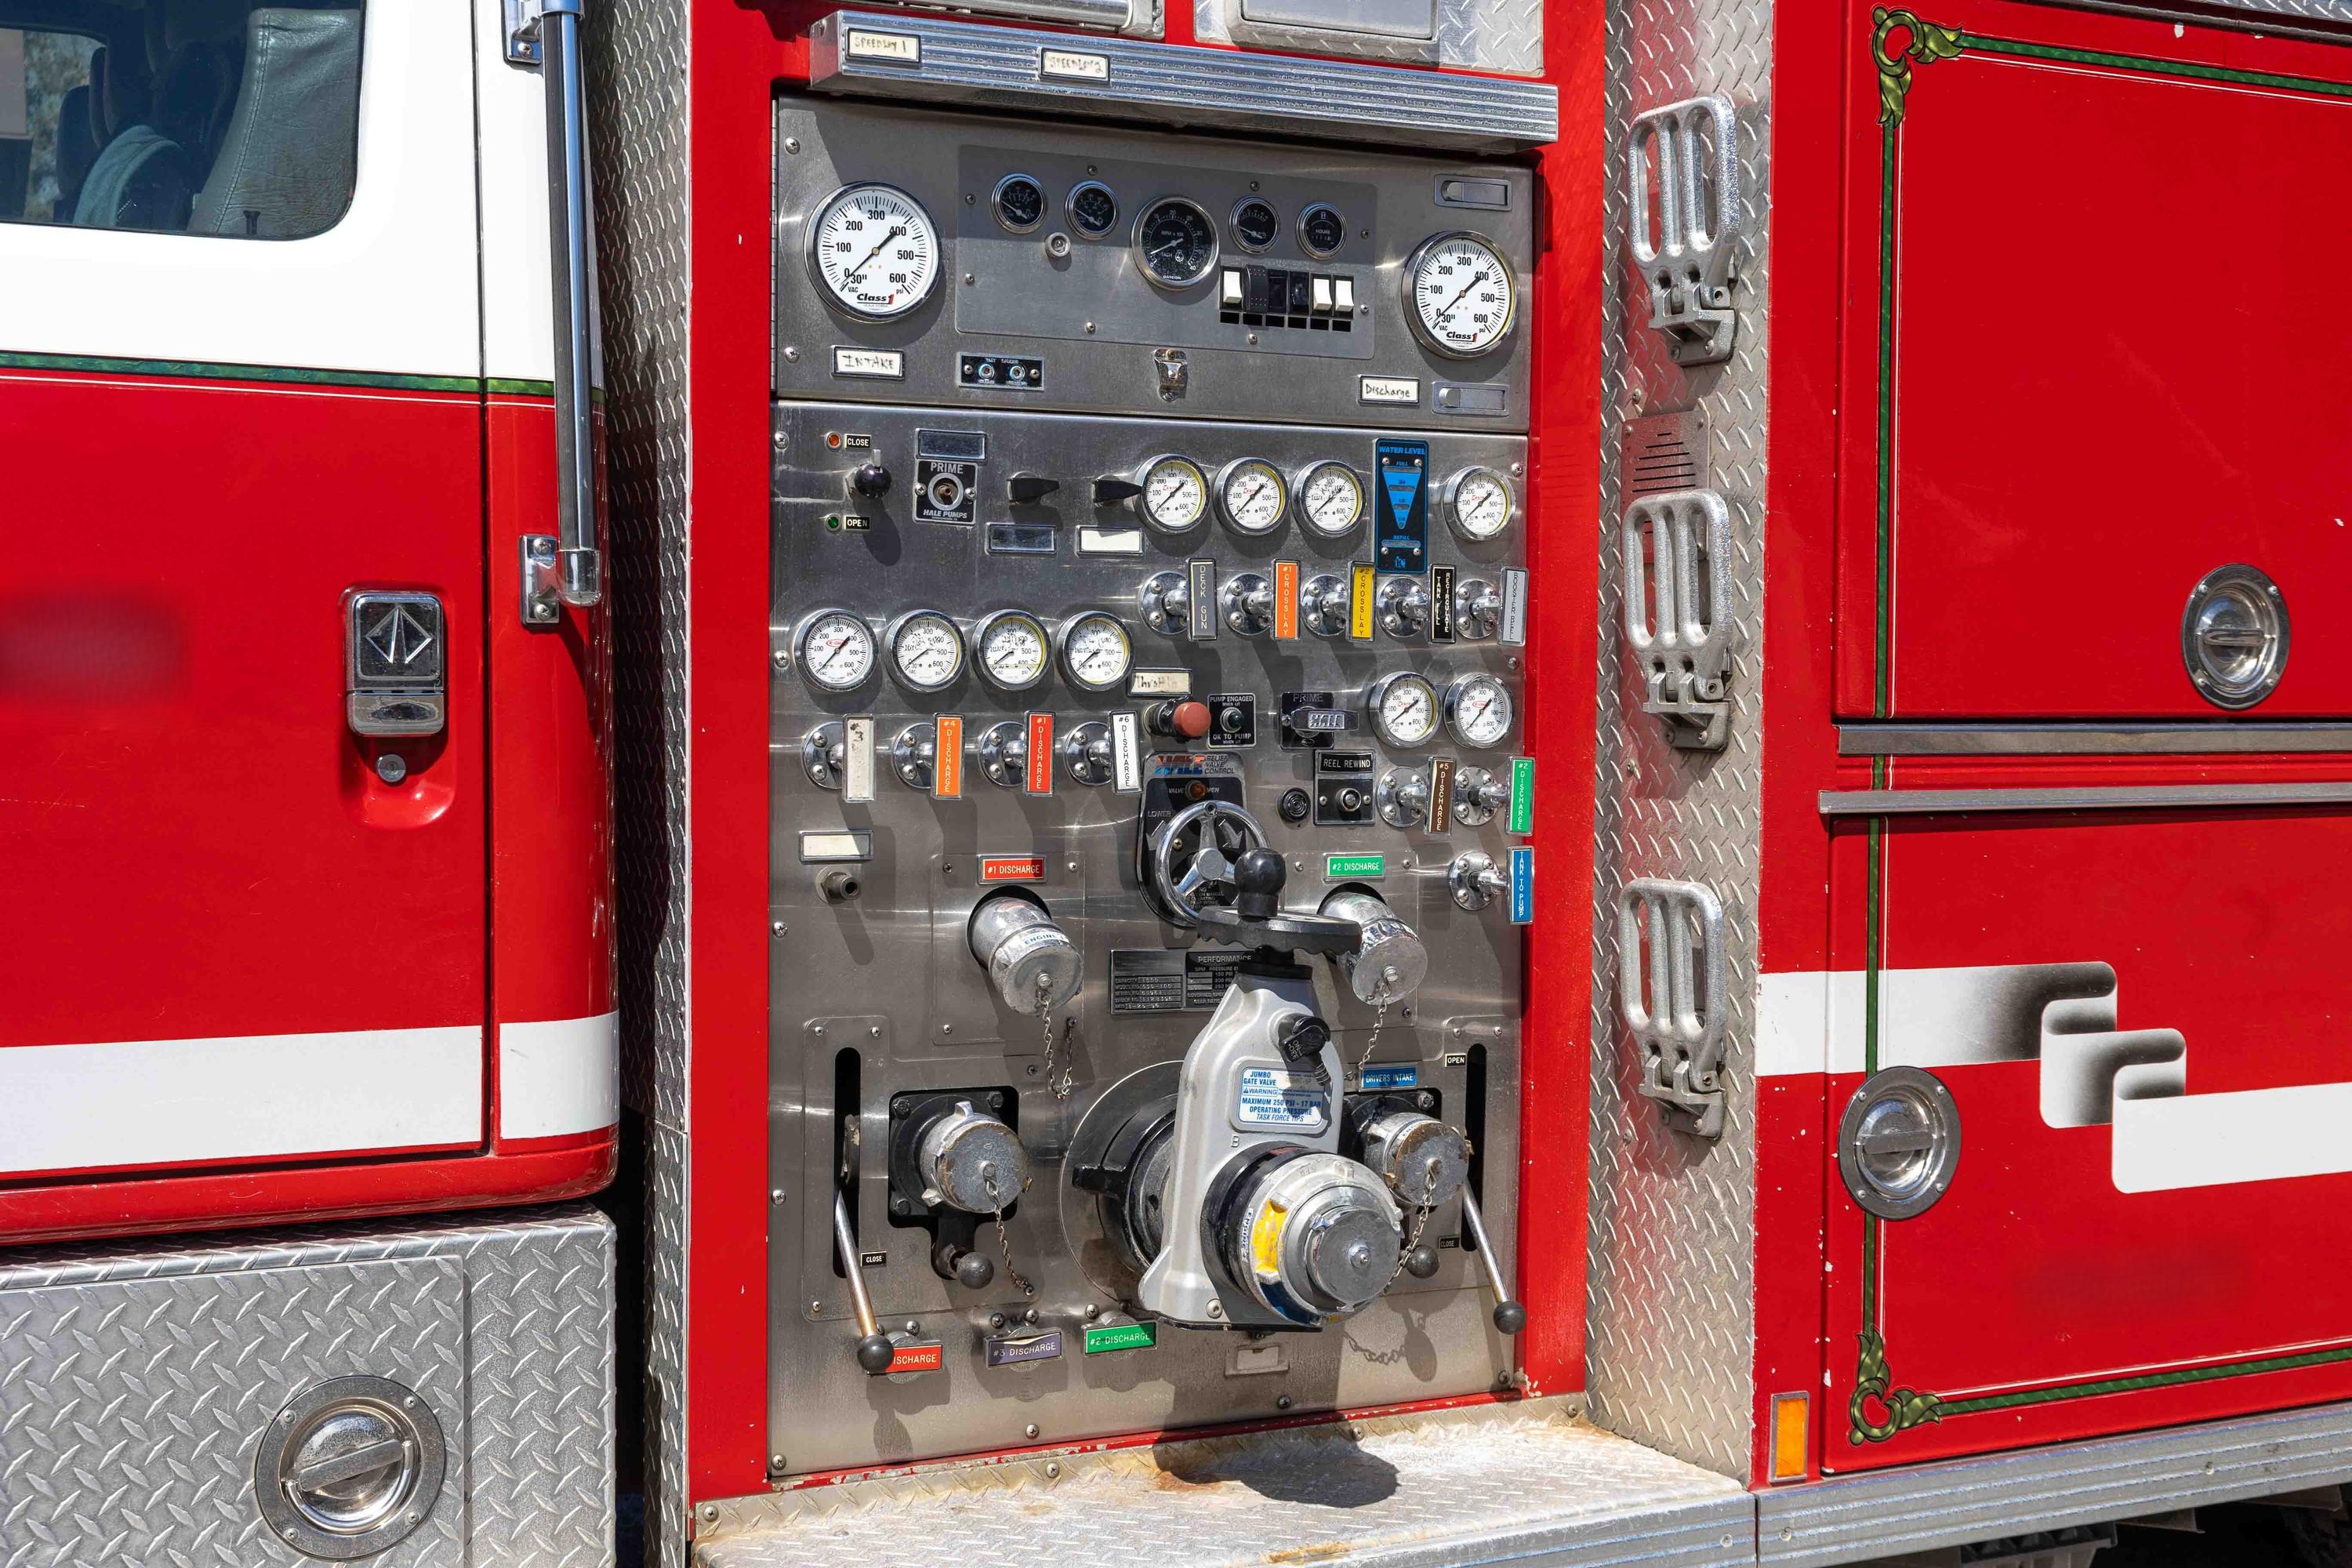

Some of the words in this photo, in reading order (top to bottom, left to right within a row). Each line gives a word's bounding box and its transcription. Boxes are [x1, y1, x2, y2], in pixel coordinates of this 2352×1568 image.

[867, 210, 885, 220] 300
[845, 220, 863, 231] 200
[836, 242, 851, 252] 100
[897, 250, 914, 260] 500
[1457, 256, 1472, 266] 300
[1438, 265, 1453, 275] 200
[889, 273, 906, 283] 600
[1429, 285, 1443, 294] 100
[1480, 293, 1495, 303] 500
[1473, 314, 1488, 323] 600
[1365, 383, 1410, 399] Discharge
[847, 437, 869, 447] CLOSE
[930, 462, 964, 474] PRIME
[923, 509, 942, 517] HALE
[942, 510, 967, 519] PUMPS
[847, 518, 868, 527] OPEN
[1199, 564, 1207, 598] DECK
[1294, 693, 1324, 702] PRIME
[944, 729, 953, 793] DISCHARGE
[1036, 726, 1044, 789] DISCHARGE
[1121, 725, 1130, 787] DISCHARGE
[1323, 758, 1341, 768] REEL
[1344, 759, 1370, 768] REWIND
[1436, 771, 1446, 831] DISCHARGE
[987, 866, 996, 874] #1
[999, 865, 1040, 874] DISCHARGE
[1344, 862, 1380, 871] DISCHARGE
[1519, 879, 1524, 891] TO
[1366, 1075, 1391, 1083] DRIVERS
[1392, 1073, 1414, 1082] INTAKE
[1090, 1337, 1101, 1346] #2
[1105, 1332, 1151, 1345] DISCHARGE
[993, 1348, 1005, 1357] #3
[1009, 1341, 1056, 1356] DISCHARGE
[893, 1354, 937, 1366] ISCHARGE
